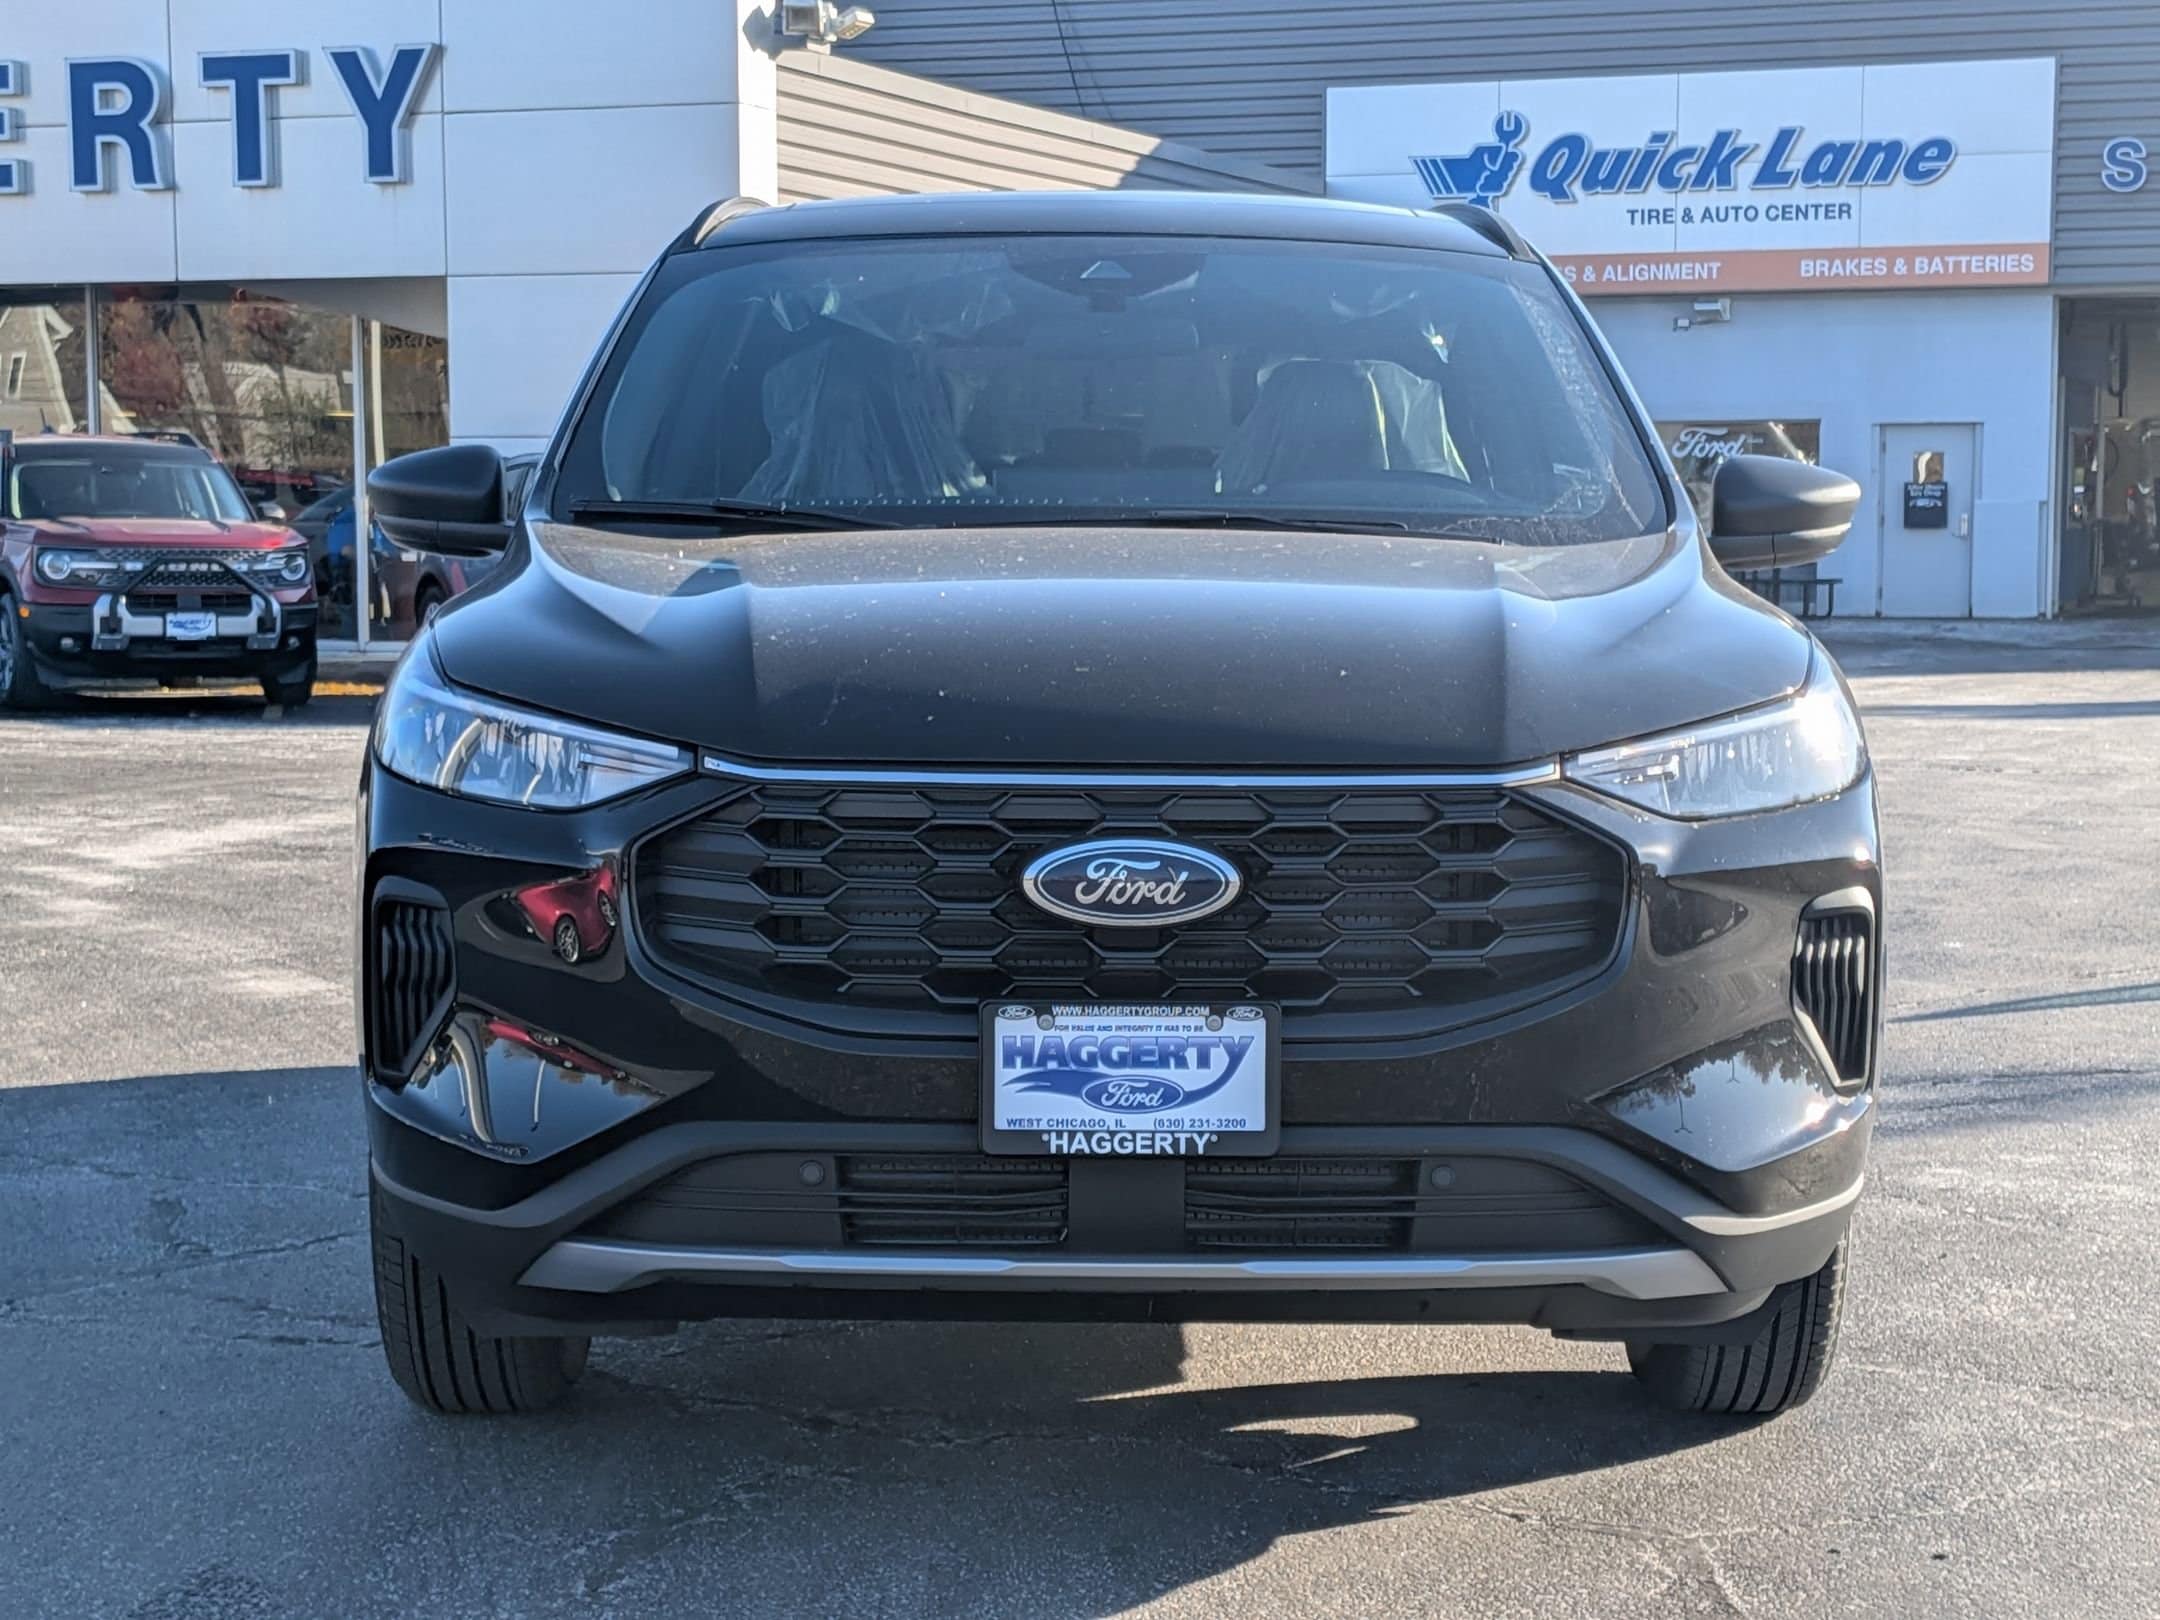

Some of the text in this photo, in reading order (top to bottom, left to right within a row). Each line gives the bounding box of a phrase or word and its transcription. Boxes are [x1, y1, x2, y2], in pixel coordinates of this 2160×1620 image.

[0, 43, 441, 194] RTY
[1529, 126, 1956, 203] Quick Lane
[2102, 137, 2146, 192] S
[1627, 203, 1851, 225] TIRE & AUTO CENTER
[1583, 264, 1597, 282] &
[1602, 262, 1721, 282] ALIGNMENT
[1800, 254, 2034, 277] BRAKES & BATTERIES
[1672, 427, 1746, 458] Ford
[1075, 858, 1189, 905] Ford
[1051, 1005, 1210, 1016] WWW.HAGGERTYGROUP.COM
[1002, 1035, 1255, 1070] HAGGERTY
[1101, 1081, 1163, 1107] Ford
[1006, 1117, 1126, 1131] WEST CHICAGO, IL
[1189, 1117, 1246, 1128] 231-3200
[1049, 1131, 1210, 1155] HAGGERTY
